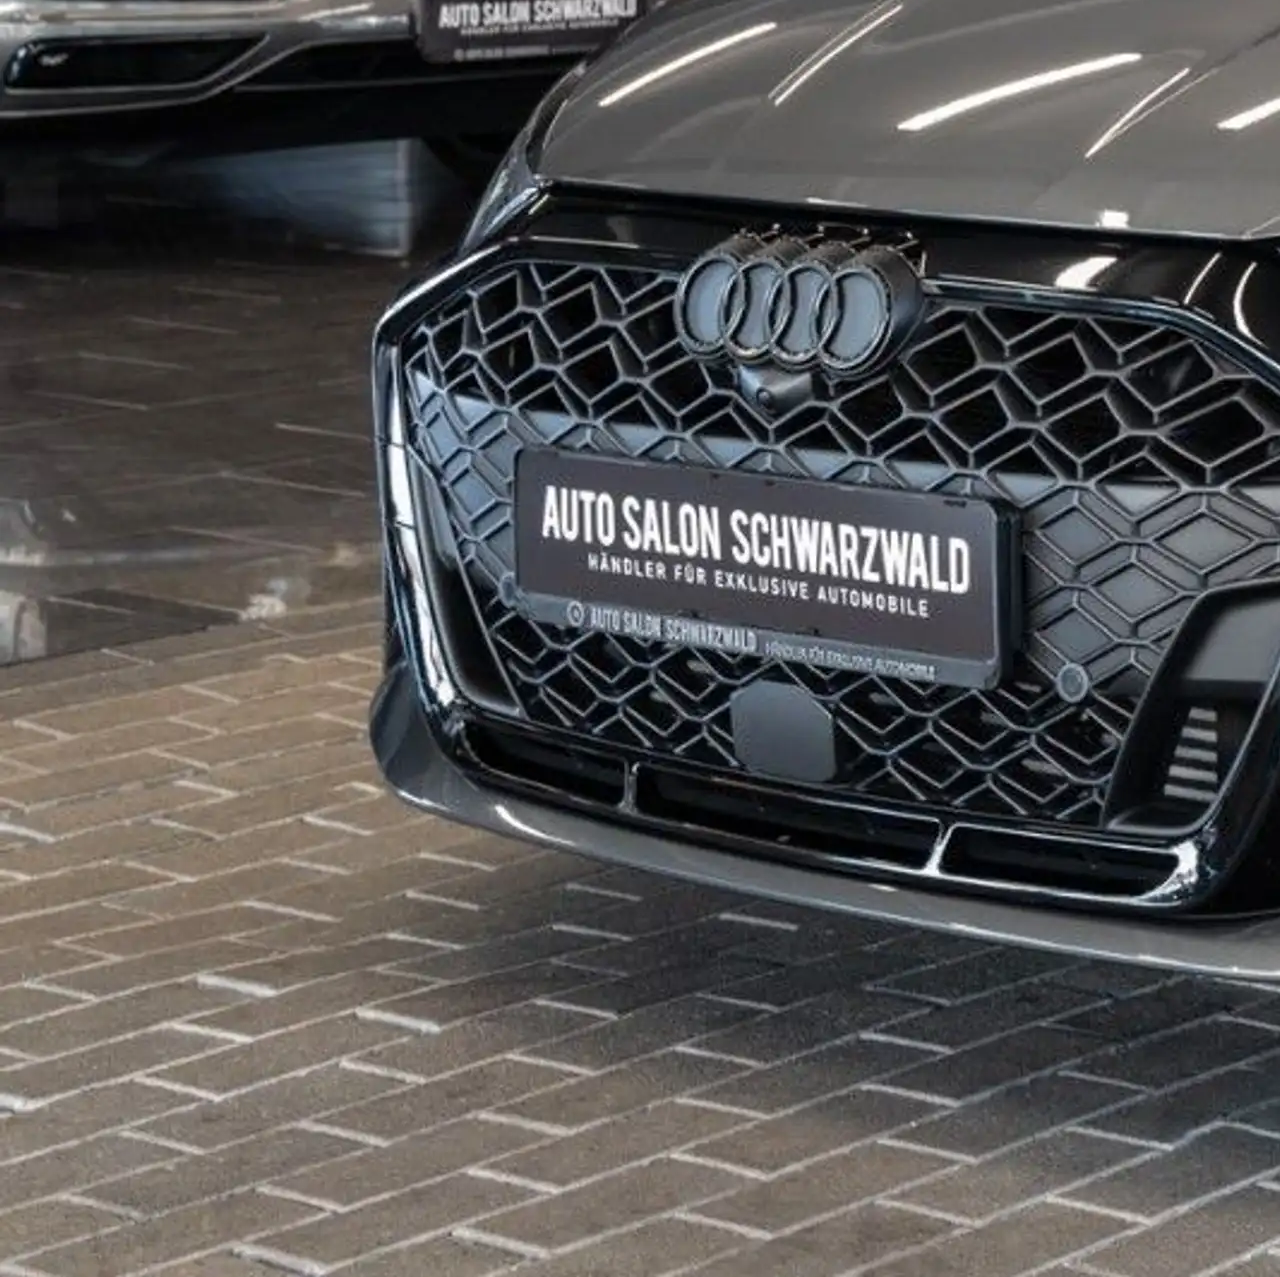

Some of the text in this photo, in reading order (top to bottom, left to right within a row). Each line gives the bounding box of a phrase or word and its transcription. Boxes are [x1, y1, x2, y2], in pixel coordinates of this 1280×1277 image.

[438, 3, 480, 29] AUTO
[482, 0, 531, 27] SALON
[542, 484, 970, 595] AUTO SALON SCHWARZWALD
[587, 552, 930, 618] HÄNDLER FÜR EXKLUSIVE AUTOMOBILE
[590, 607, 621, 631] AUTO
